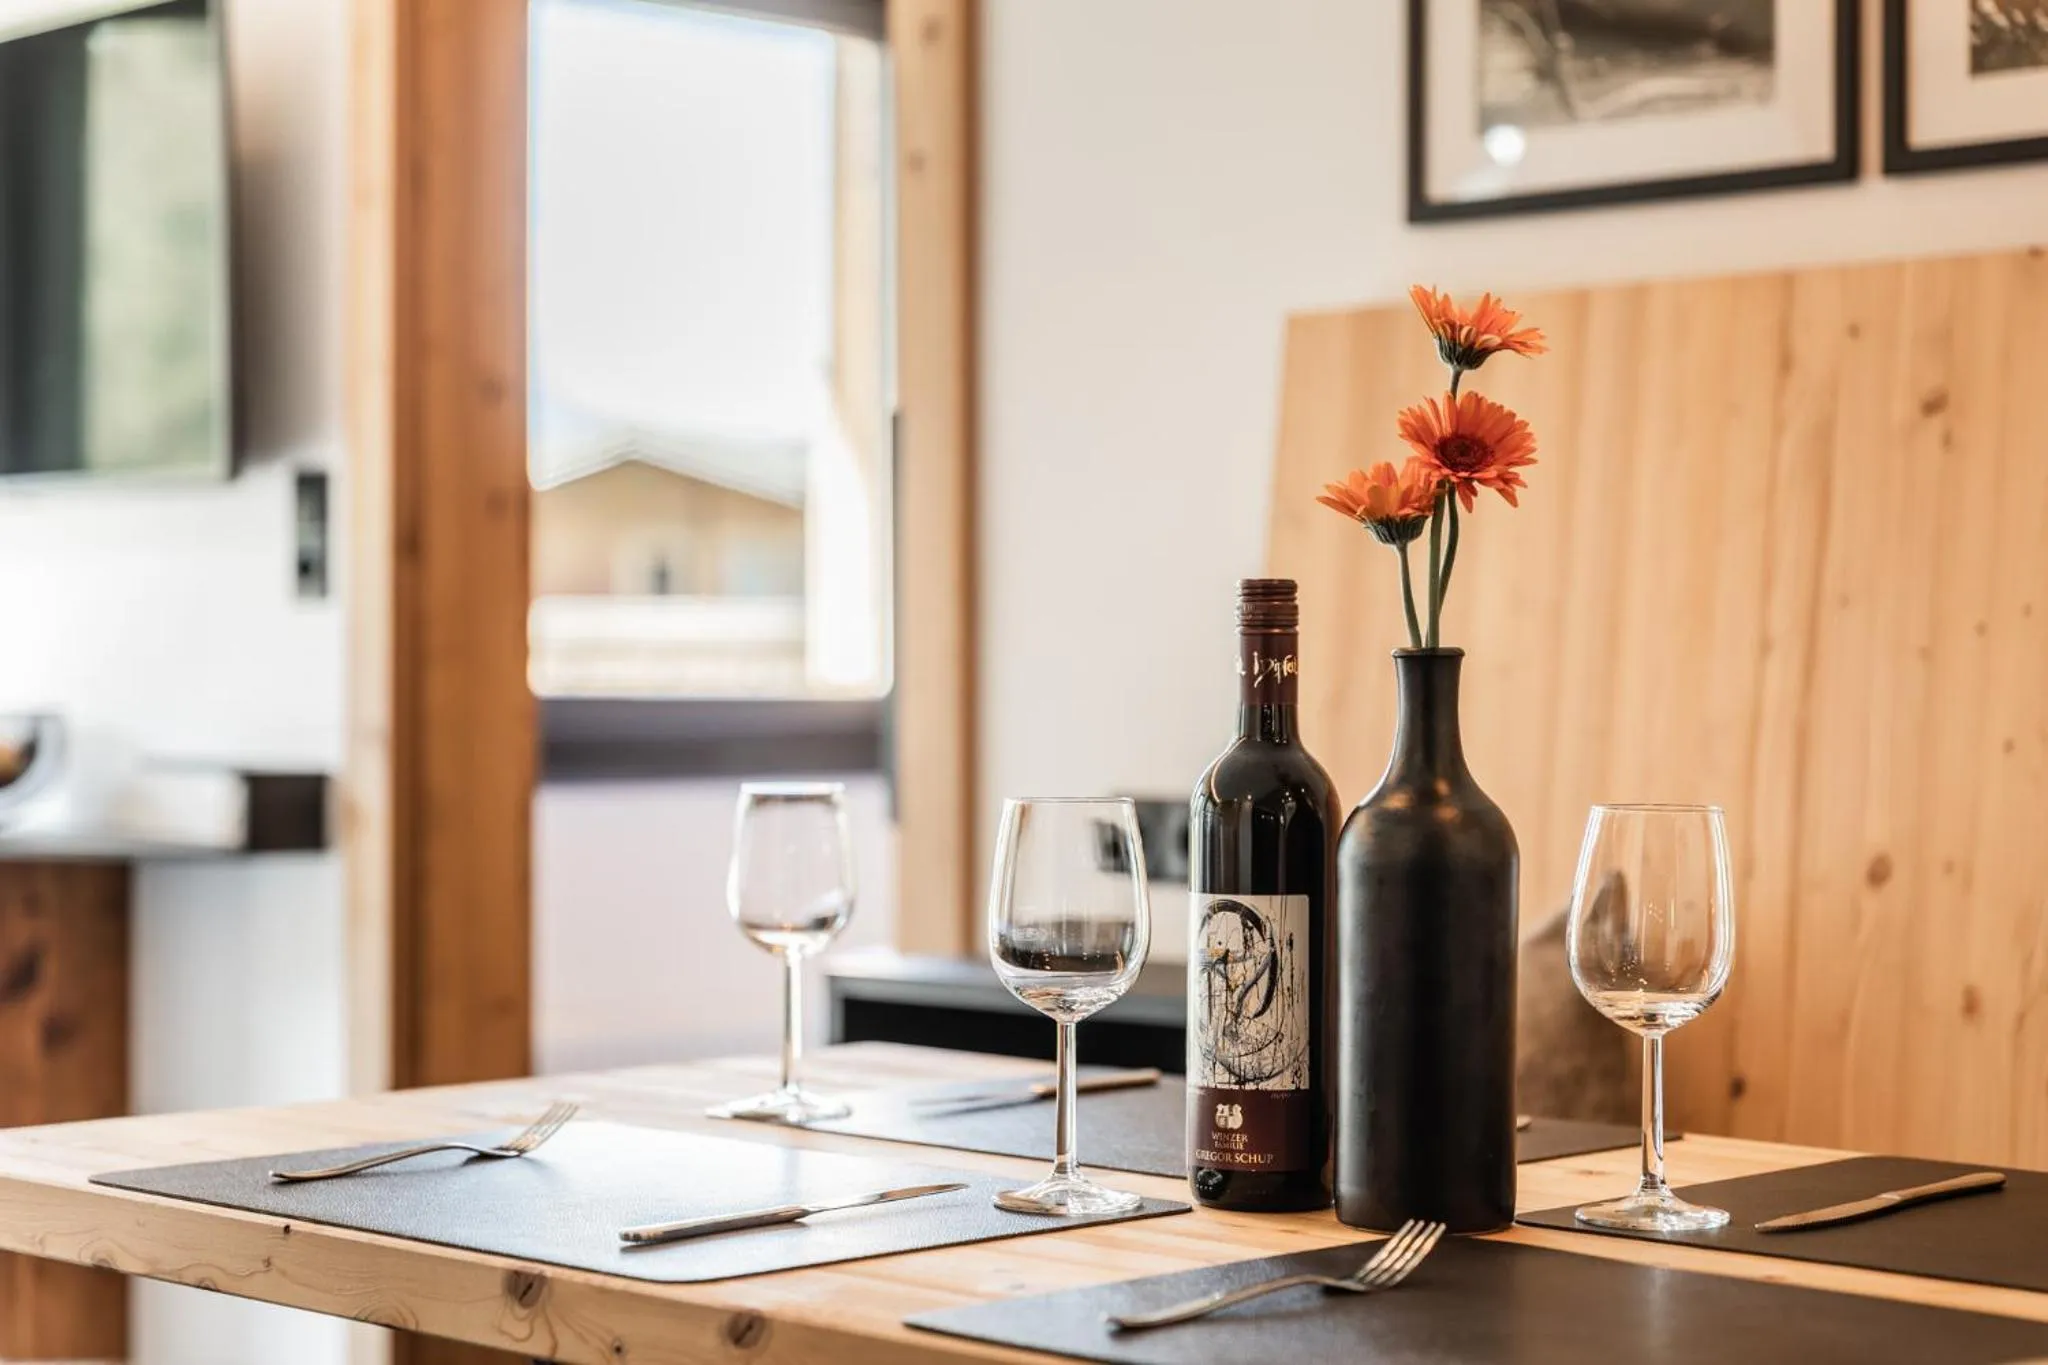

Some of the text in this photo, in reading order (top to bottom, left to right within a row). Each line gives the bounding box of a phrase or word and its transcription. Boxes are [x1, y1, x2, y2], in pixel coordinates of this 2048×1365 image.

[1212, 1131, 1248, 1142] WINZER
[1196, 1149, 1273, 1164] GREGOR SCHUP
